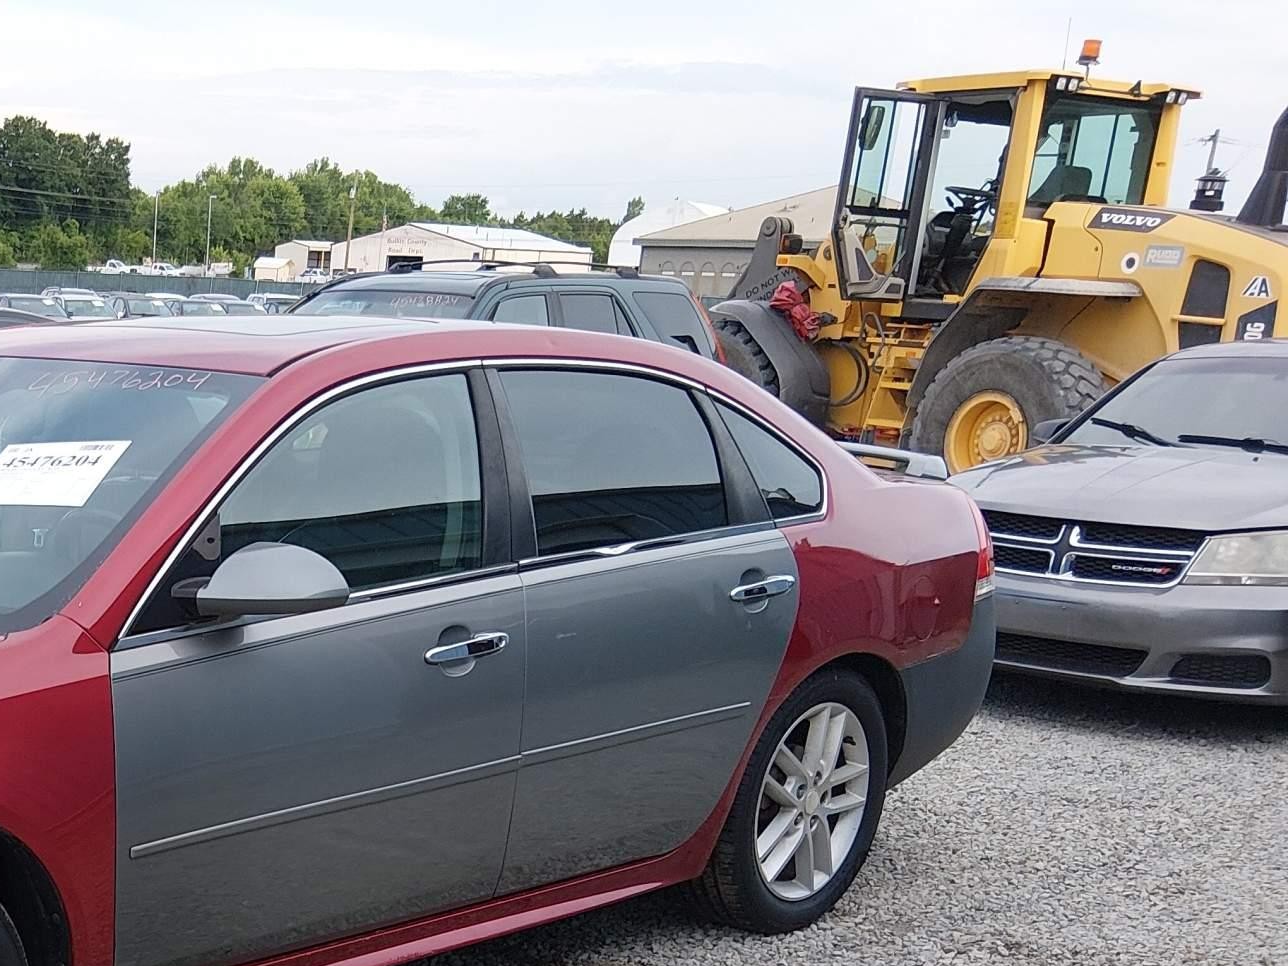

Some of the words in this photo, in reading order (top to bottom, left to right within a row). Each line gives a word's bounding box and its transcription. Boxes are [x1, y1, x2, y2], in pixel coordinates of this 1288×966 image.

[1101, 213, 1161, 227] VOLVO
[407, 239, 428, 247] County
[746, 286, 759, 298] DO
[761, 274, 779, 289] NOT
[29, 370, 212, 397] 45476204
[2, 455, 103, 468] 45476204
